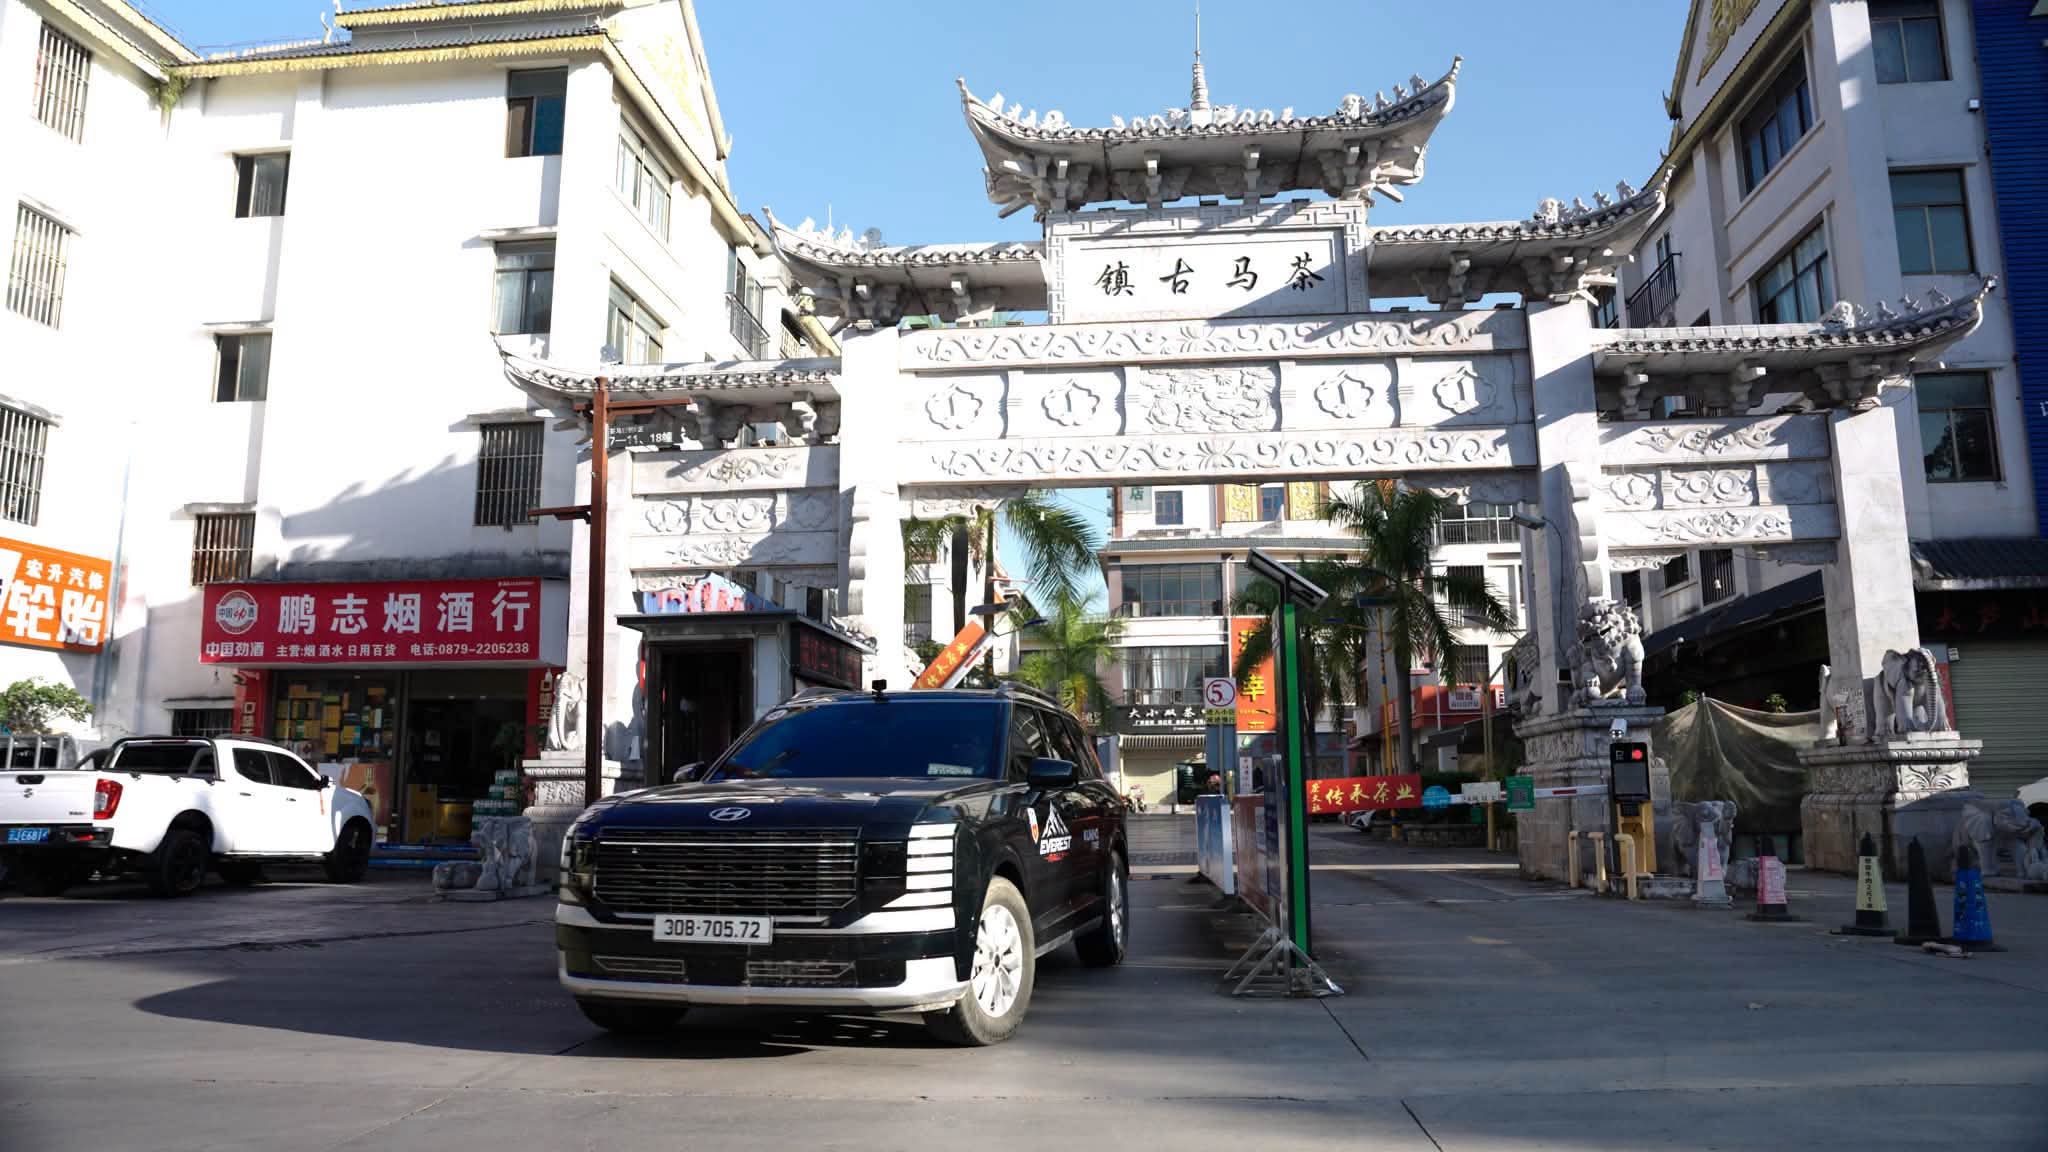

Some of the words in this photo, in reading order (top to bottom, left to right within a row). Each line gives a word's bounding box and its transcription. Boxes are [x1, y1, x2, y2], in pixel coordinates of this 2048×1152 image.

[6, 578, 105, 646] 轮胎
[277, 590, 531, 635] 鹏志烟酒行
[205, 641, 265, 657] 中国劲酒
[1325, 781, 1416, 806] 传承茶业
[1039, 835, 1072, 855] EVEREST
